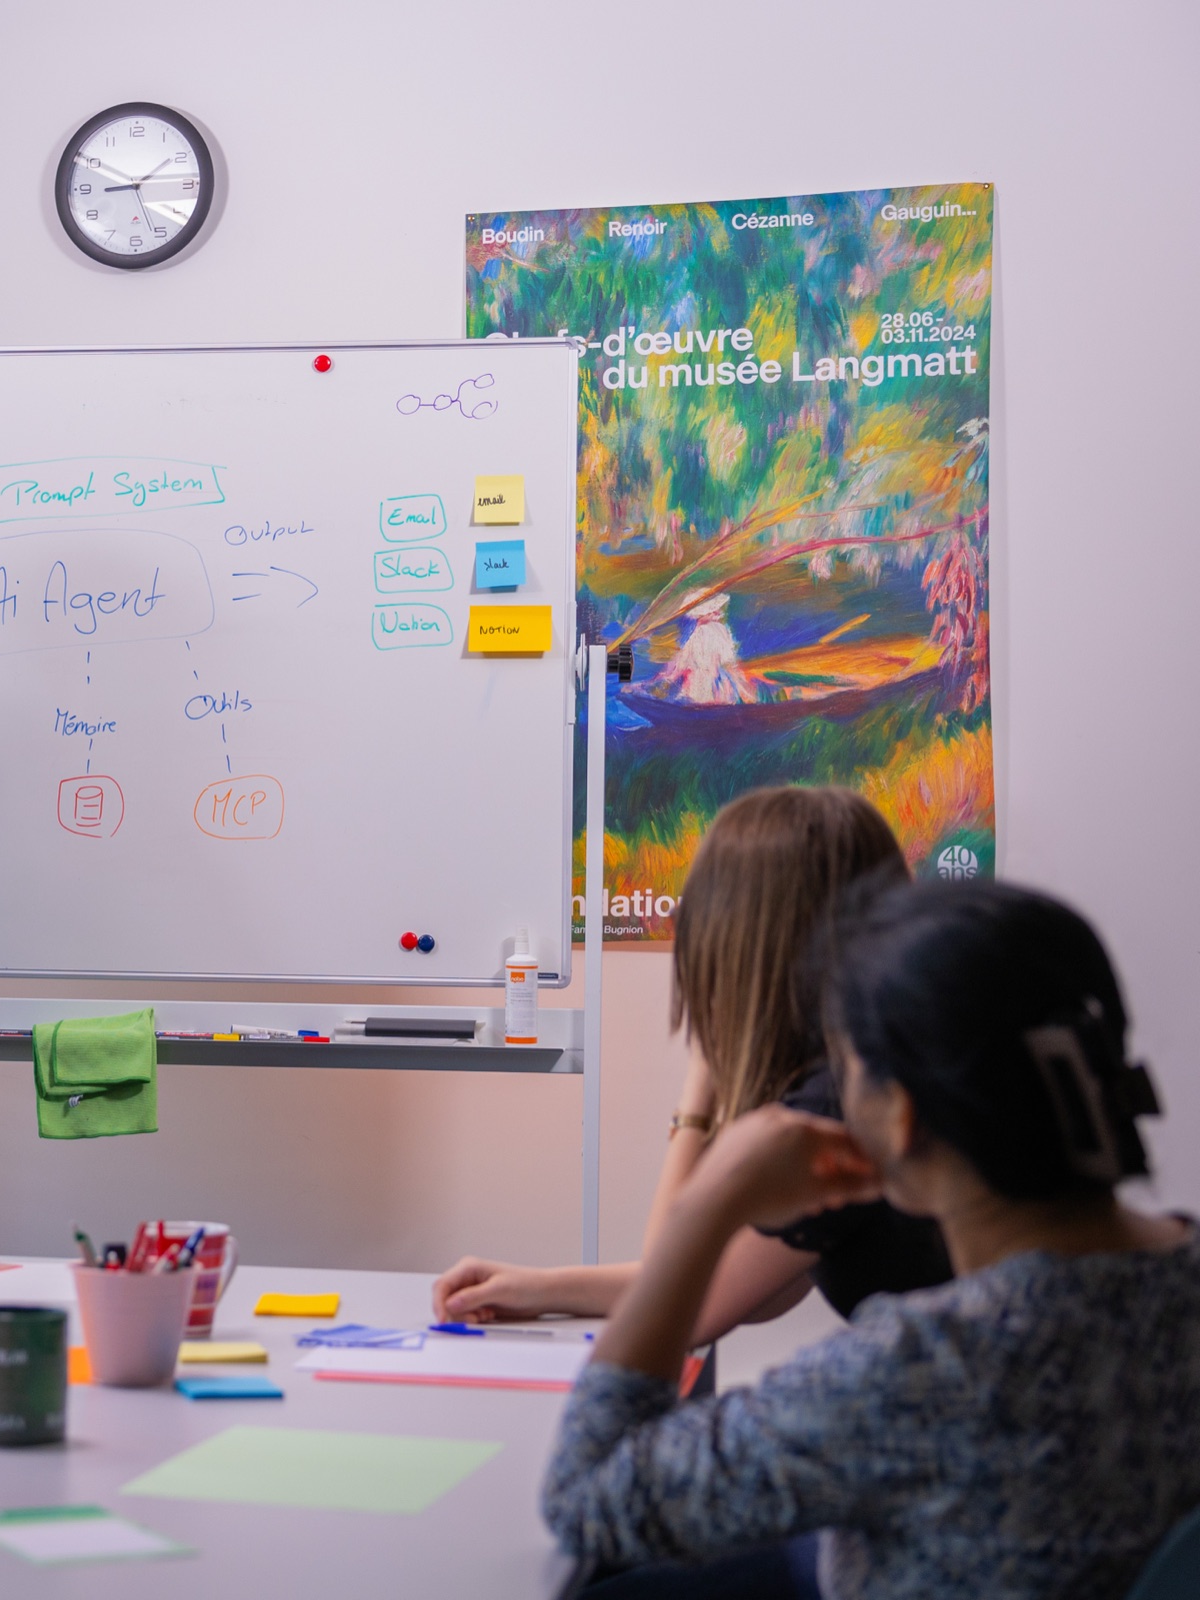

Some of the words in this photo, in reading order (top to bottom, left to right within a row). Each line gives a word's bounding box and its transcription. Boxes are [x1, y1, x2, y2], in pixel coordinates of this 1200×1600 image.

[106, 136, 115, 147] 11
[129, 126, 145, 138] 12
[86, 158, 101, 169] 10
[174, 152, 187, 163] 2
[79, 184, 92, 195] 9
[181, 178, 195, 190] 3
[86, 209, 99, 221] 8
[482, 225, 544, 245] Boudin
[608, 218, 668, 238] Renoir
[731, 210, 814, 230] Cézanne
[881, 200, 977, 223] Gauguin...
[104, 229, 116, 241] 7
[130, 236, 143, 247] 6
[154, 227, 167, 238] 5
[881, 324, 977, 344] 03.11.2024
[602, 359, 648, 390] du
[658, 353, 782, 388] musée
[792, 345, 977, 387] Langmatt
[0, 471, 97, 506] Prompt
[113, 471, 203, 507] System
[224, 520, 315, 546] Output
[380, 553, 440, 578] Slack
[43, 560, 166, 634] Agent
[380, 610, 441, 633] Notion
[184, 690, 253, 720] Outils
[54, 707, 117, 736] Mémoire
[212, 787, 267, 827] MCP
[943, 846, 972, 867] 40
[603, 925, 644, 936] Bugnion
